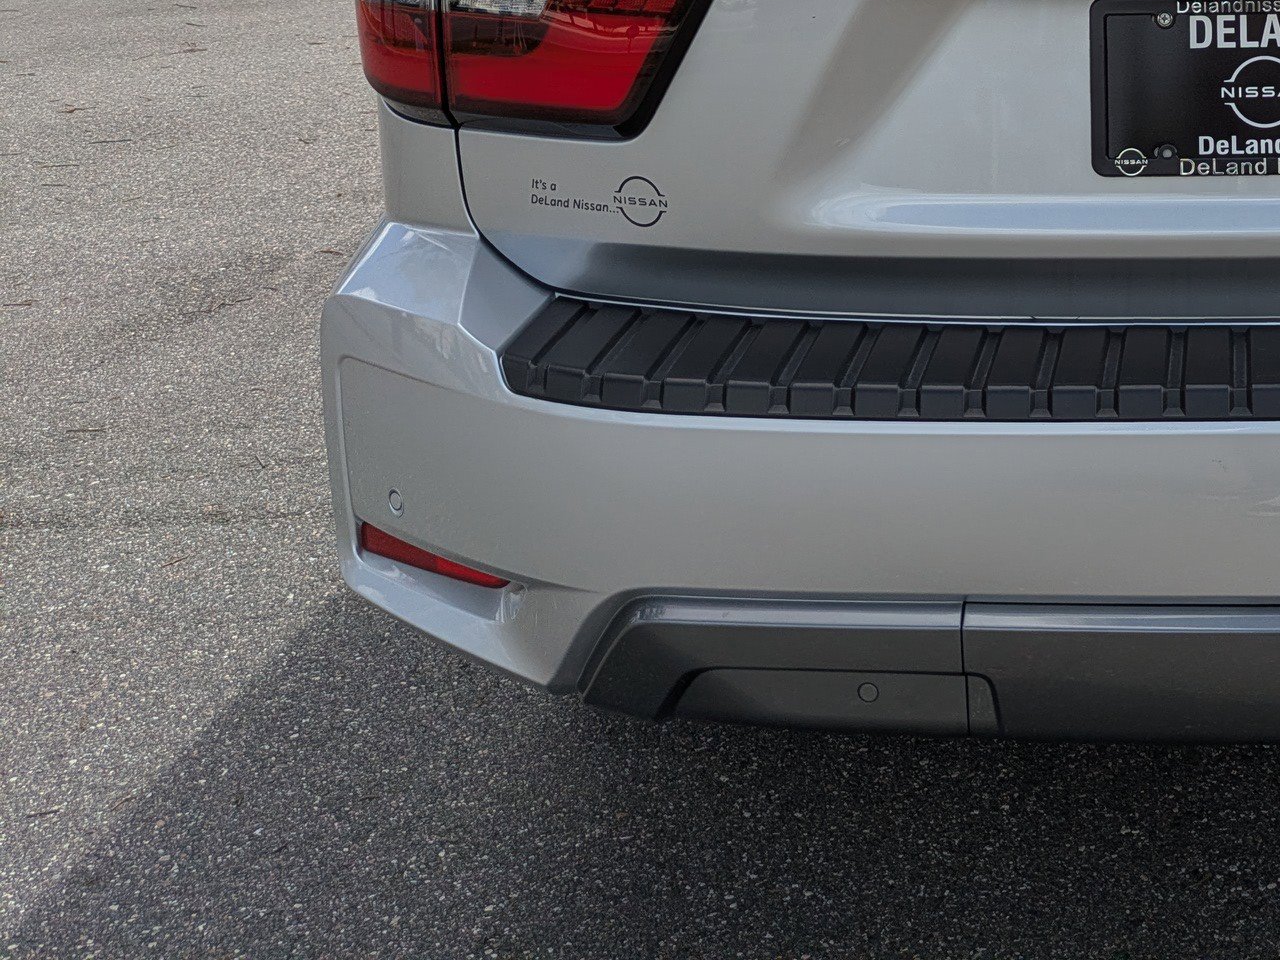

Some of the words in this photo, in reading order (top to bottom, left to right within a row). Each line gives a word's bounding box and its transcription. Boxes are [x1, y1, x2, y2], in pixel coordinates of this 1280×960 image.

[1180, 158, 1268, 176] DeLand
[531, 178, 547, 190] It's
[550, 182, 557, 191] a
[531, 193, 570, 208] DeLand
[613, 195, 668, 208] NISSAN
